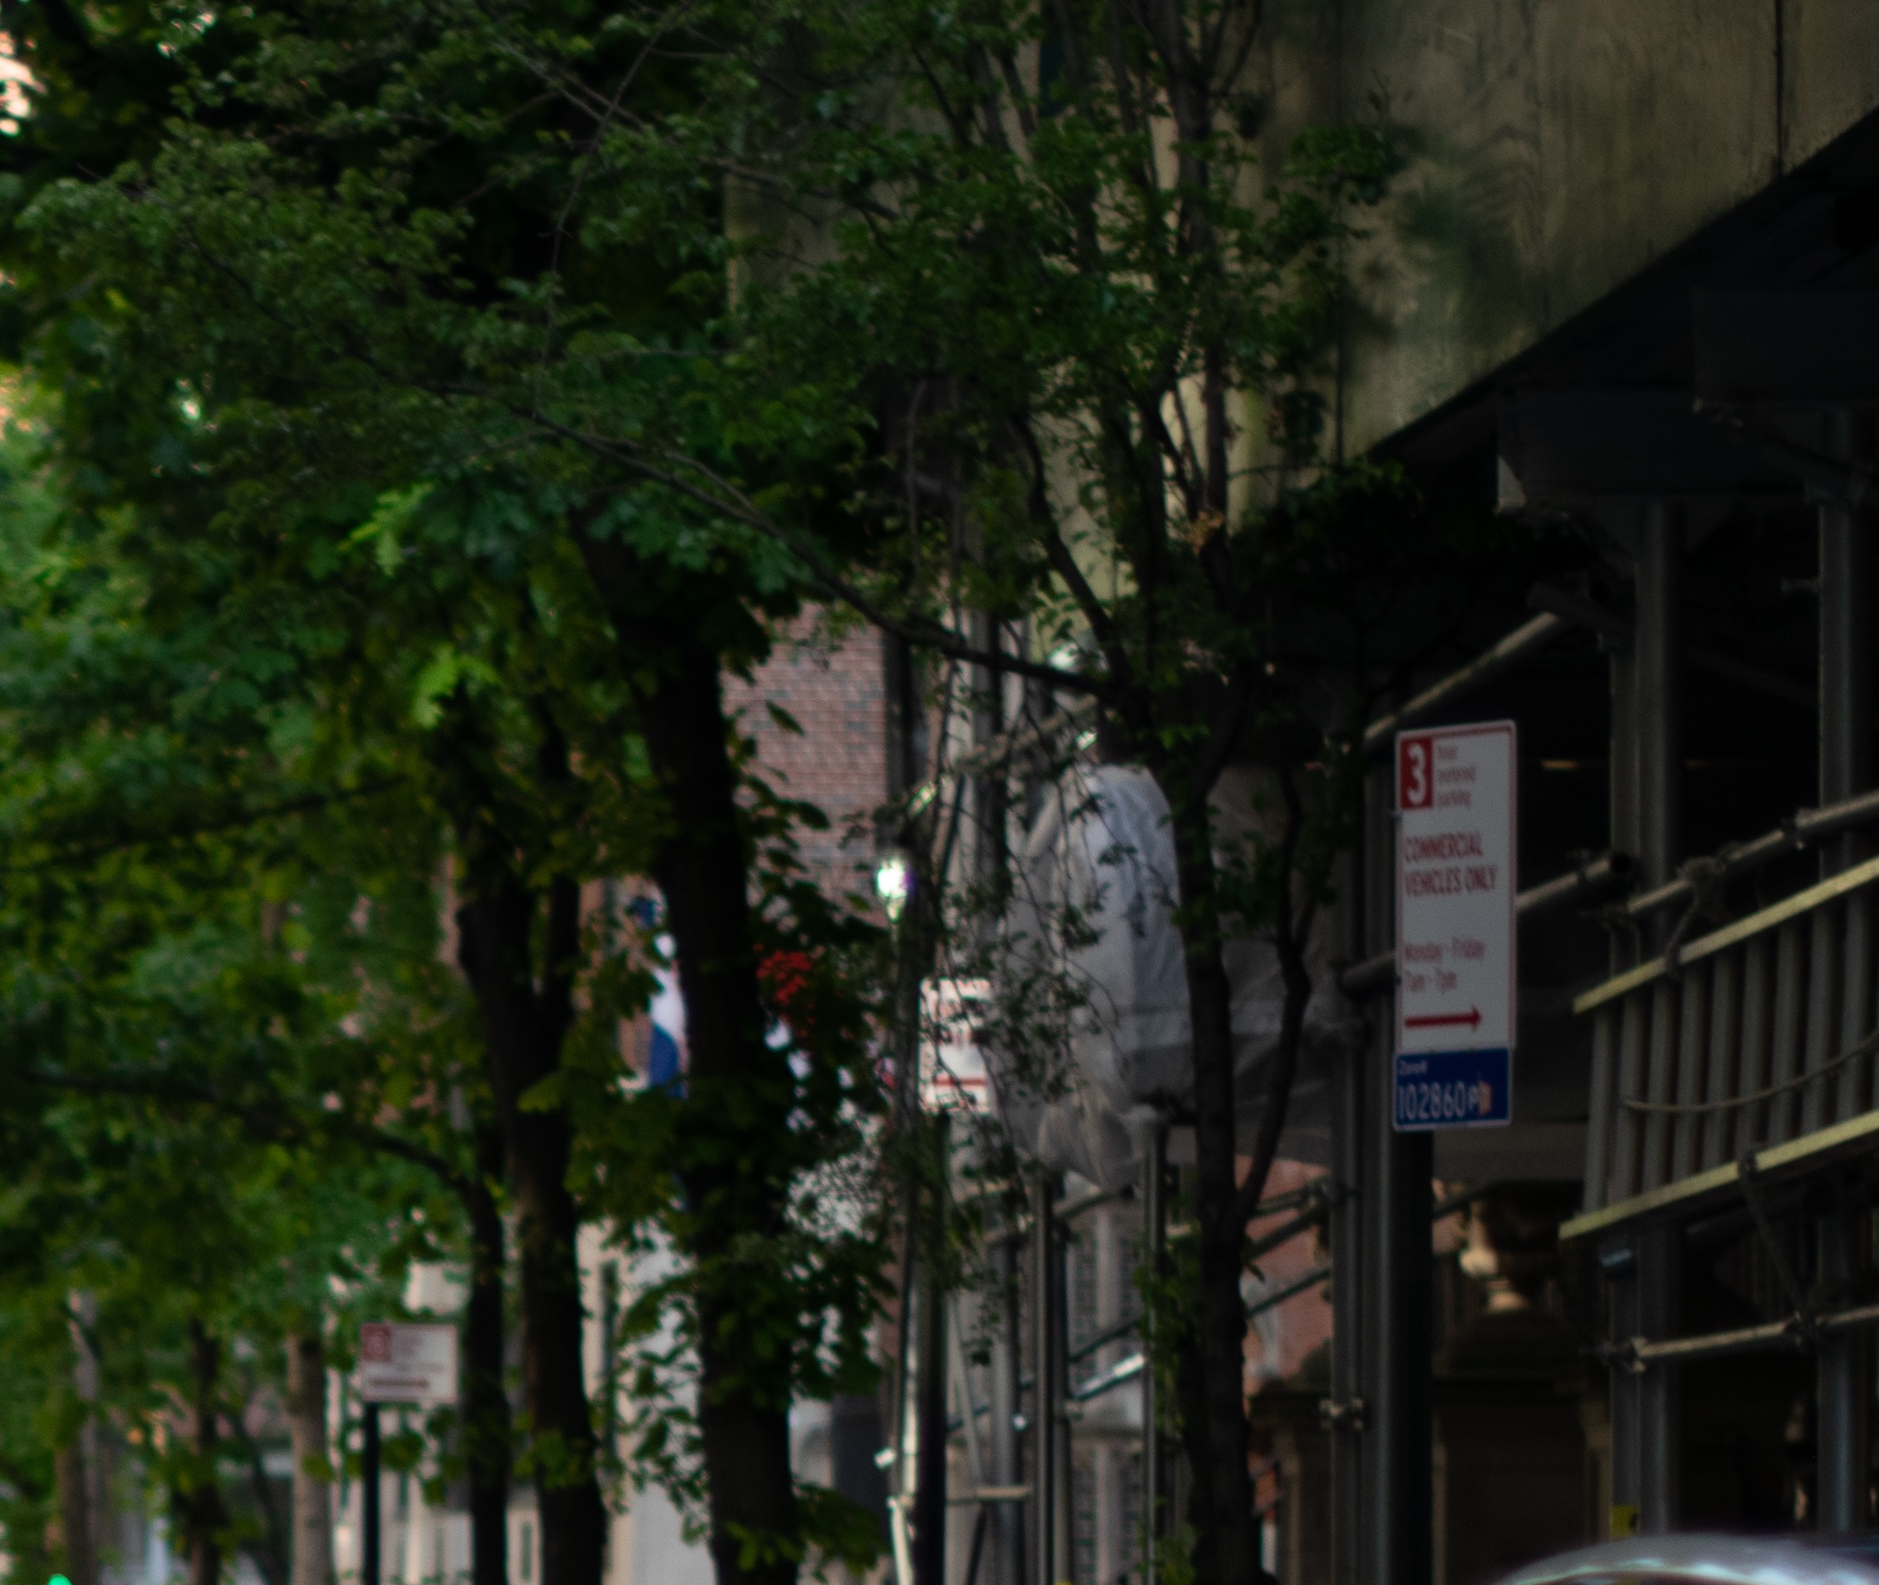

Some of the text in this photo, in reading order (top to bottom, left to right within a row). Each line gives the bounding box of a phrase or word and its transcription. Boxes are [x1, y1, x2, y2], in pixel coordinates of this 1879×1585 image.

[1406, 743, 1427, 806] 3
[1404, 831, 1484, 863] COMMERCIAL
[1404, 865, 1498, 896] VEHICLES ONLY
[1398, 1079, 1467, 1121] 102860
